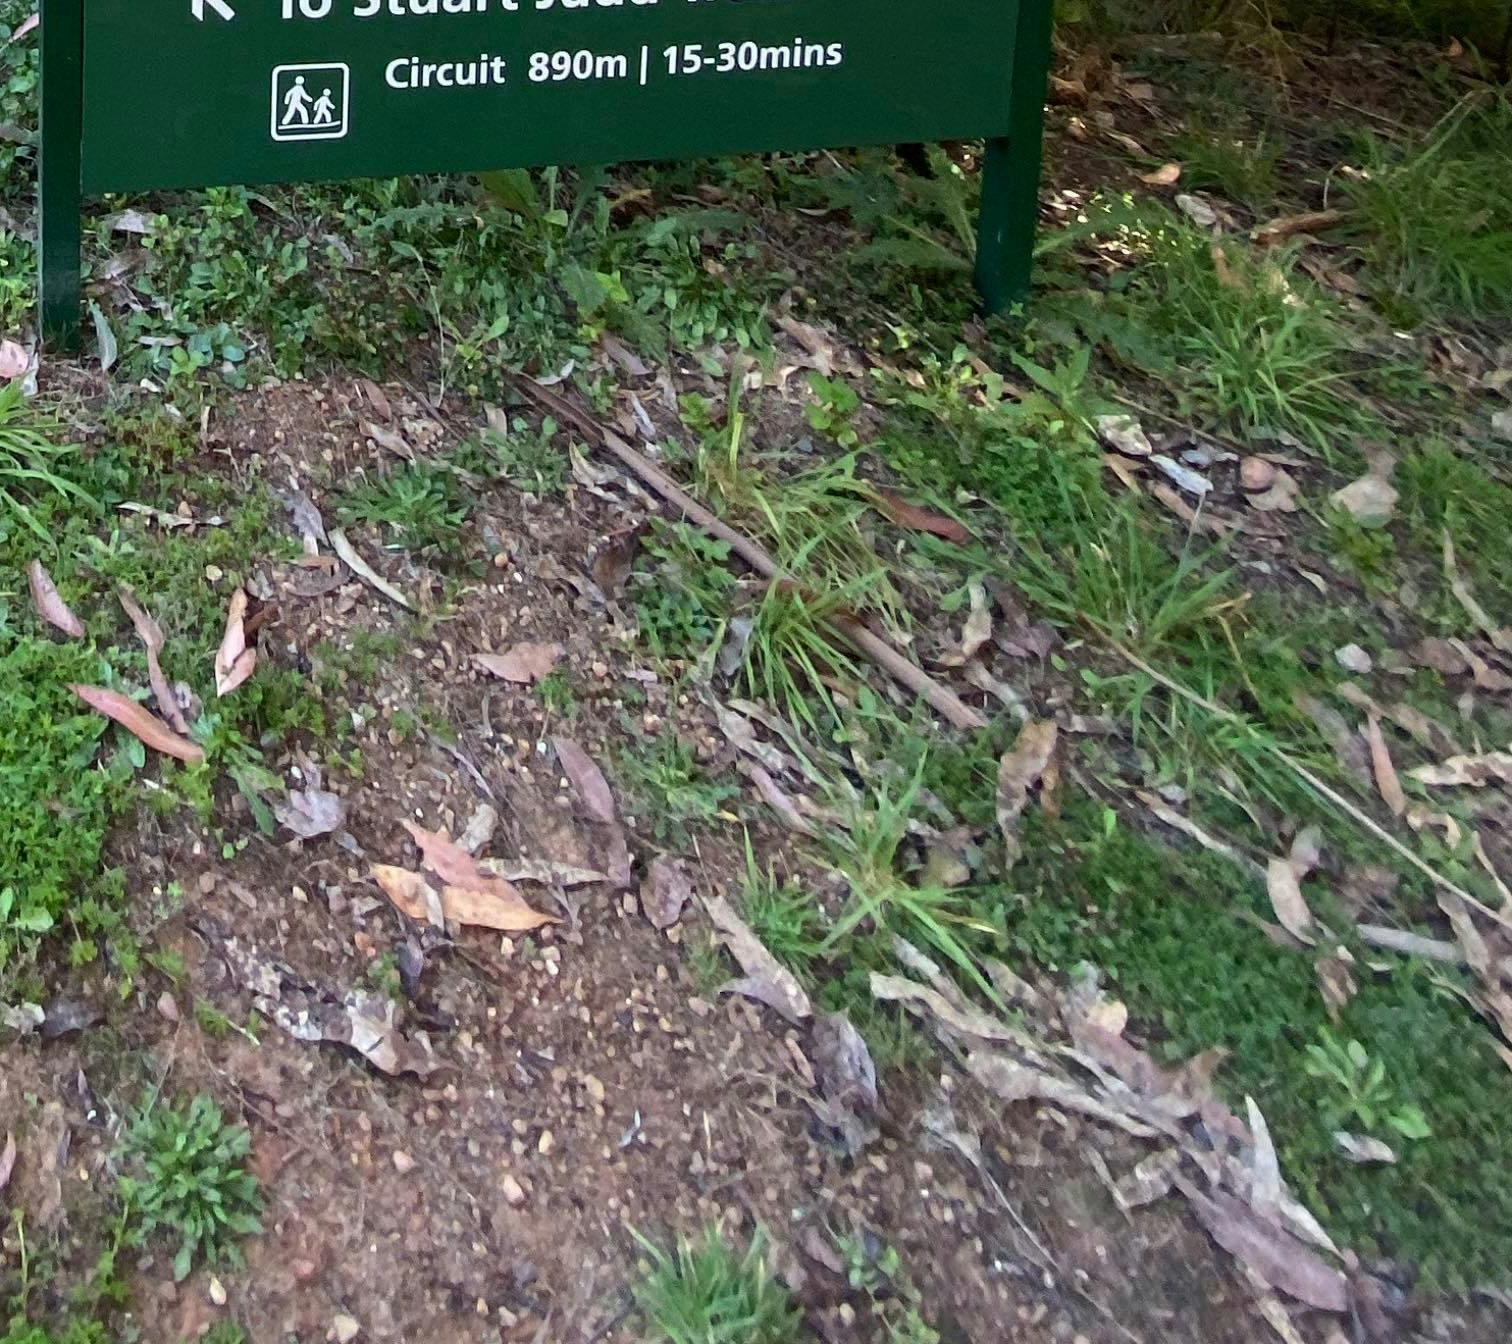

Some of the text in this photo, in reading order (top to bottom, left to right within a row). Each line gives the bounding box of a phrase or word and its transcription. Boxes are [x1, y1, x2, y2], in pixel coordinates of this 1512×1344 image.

[385, 53, 506, 89] Circuit
[528, 49, 627, 82] 890m
[663, 37, 842, 75] 15-30mins
